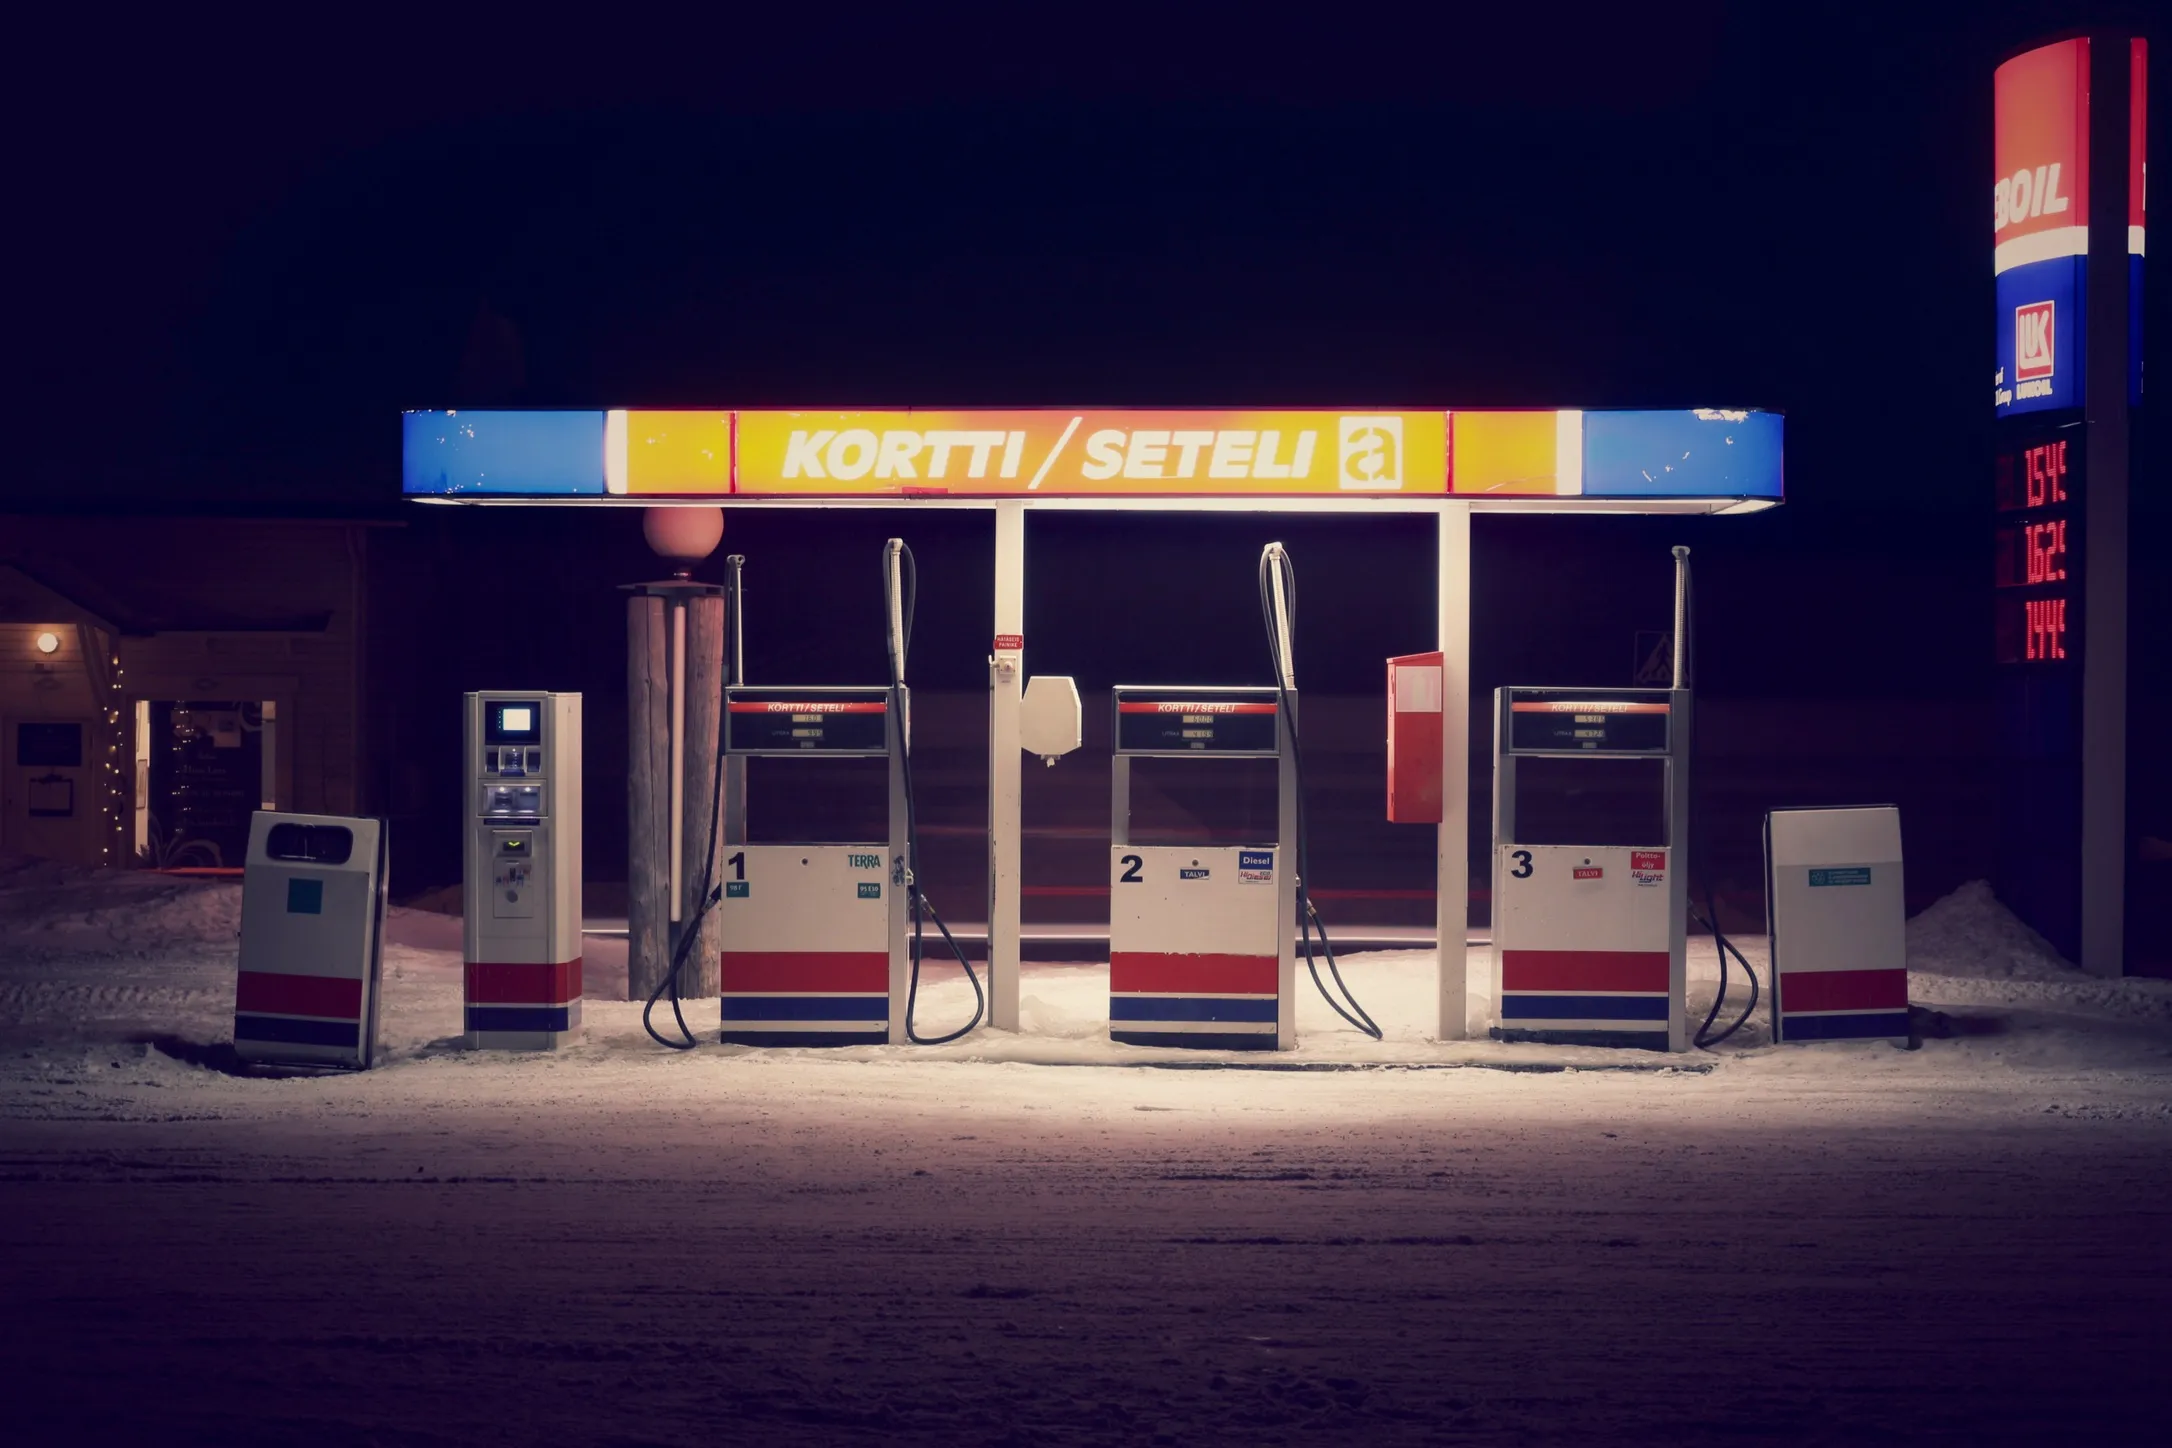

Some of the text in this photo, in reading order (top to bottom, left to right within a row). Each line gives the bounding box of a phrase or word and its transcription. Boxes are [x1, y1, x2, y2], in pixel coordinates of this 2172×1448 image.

[728, 852, 745, 880] 1
[848, 854, 881, 869] TERRA
[1120, 855, 1143, 883] 2
[1243, 857, 1270, 865] Diesel
[1511, 850, 1534, 879] 3
